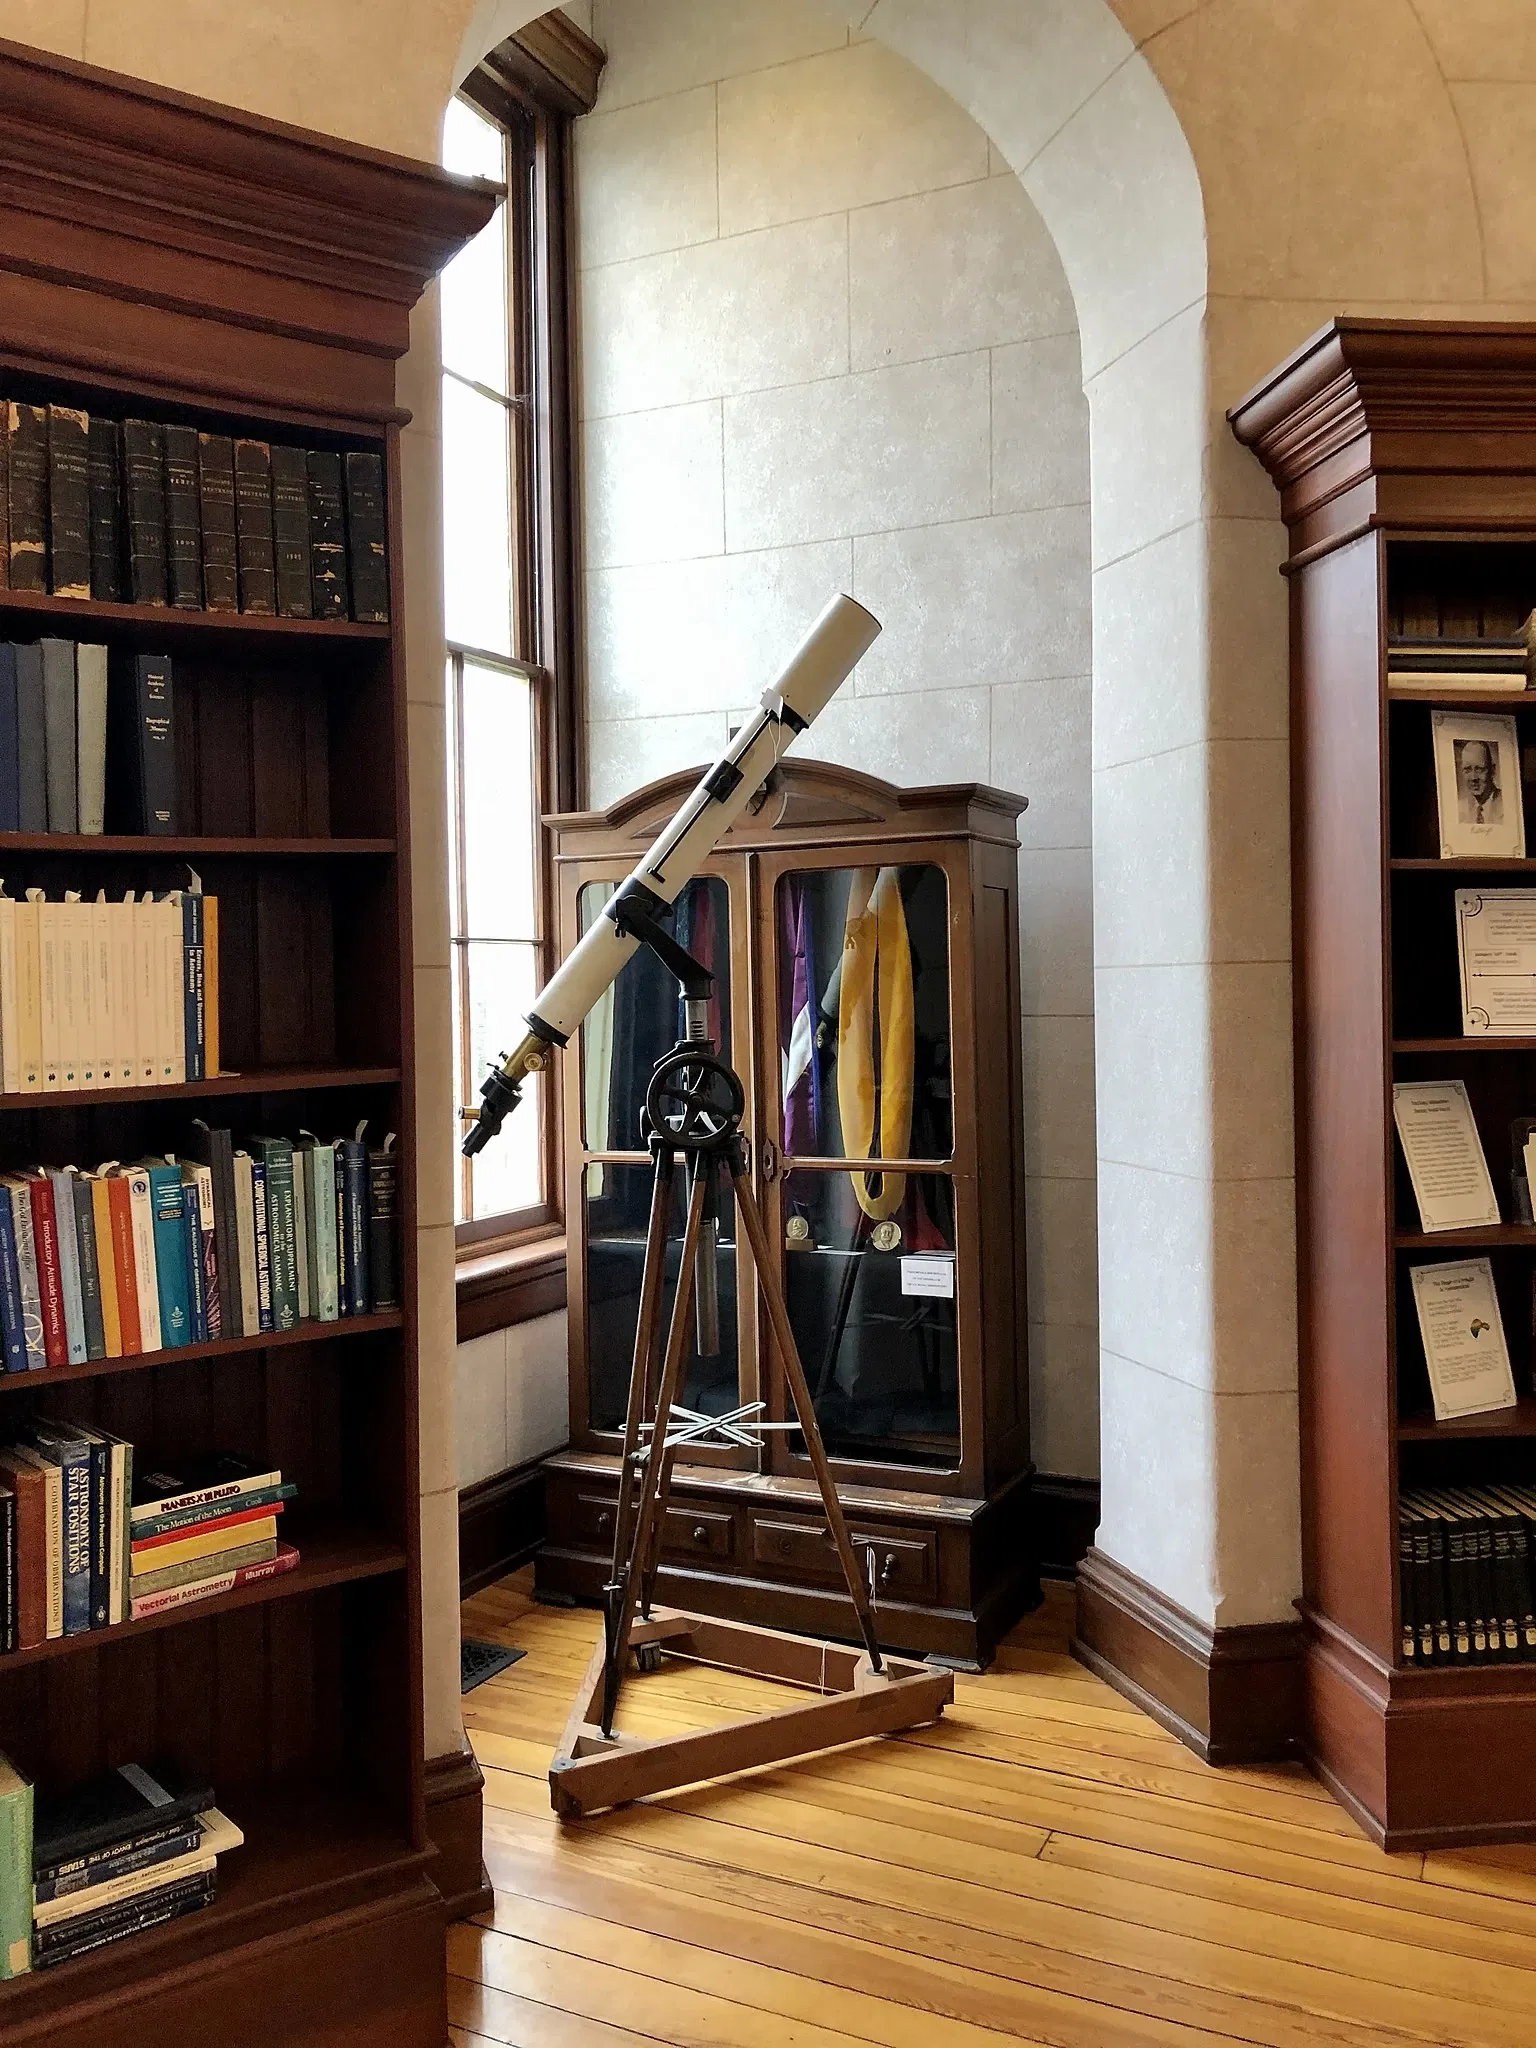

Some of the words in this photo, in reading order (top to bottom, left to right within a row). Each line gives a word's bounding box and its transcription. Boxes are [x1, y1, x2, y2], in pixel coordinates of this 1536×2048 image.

[188, 958, 196, 994] Astronomy
[18, 1190, 28, 1206] Who
[20, 1207, 28, 1219] Got
[254, 1180, 267, 1233] COMPUTATIONAL
[271, 1193, 281, 1253] ASTRONOMICAL
[283, 1190, 293, 1243] EXPLANATORY
[43, 1220, 54, 1266] Introductory
[257, 1234, 269, 1270] SPHERICAL
[280, 1233, 285, 1241] to
[193, 1258, 199, 1268] OF
[273, 1254, 283, 1292] ALMANAC
[286, 1244, 296, 1292] SUPPLEMENT
[47, 1267, 57, 1296] Attitude
[86, 1278, 95, 1291] Part
[193, 1268, 202, 1314] OBSERVATIONS
[260, 1270, 271, 1310] ASTRONOMY
[49, 1297, 60, 1335] Dynamics
[68, 1467, 80, 1503] STAR
[161, 1496, 196, 1512] PLANETS
[195, 1493, 204, 1503] X
[213, 1485, 241, 1498] PLUTO
[51, 1485, 60, 1545] COMBINATION
[79, 1467, 90, 1547] ASTRONOMY
[154, 1521, 170, 1533] The
[170, 1517, 194, 1530] Motion
[194, 1514, 202, 1523] of
[201, 1511, 212, 1521] the
[212, 1507, 232, 1519] Moon
[245, 1497, 263, 1508] Cook
[52, 1547, 60, 1558] OF
[69, 1506, 80, 1574] POSITIONS
[80, 1550, 90, 1568] OF
[98, 1548, 106, 1575] Computer
[52, 1560, 60, 1623] OBSERVATIONS
[138, 1593, 180, 1612] Vectorial
[182, 1577, 234, 1599] Astrometry
[245, 1565, 275, 1581] Murray
[58, 1859, 86, 1876] STARS
[88, 1855, 101, 1864] THE
[102, 1852, 110, 1861] OF
[111, 1843, 132, 1856] ENVOY
[71, 1938, 107, 1956] ADVENTURES
[113, 1925, 140, 1940] CELESTIAL
[141, 1913, 171, 1928] MECHANICS
